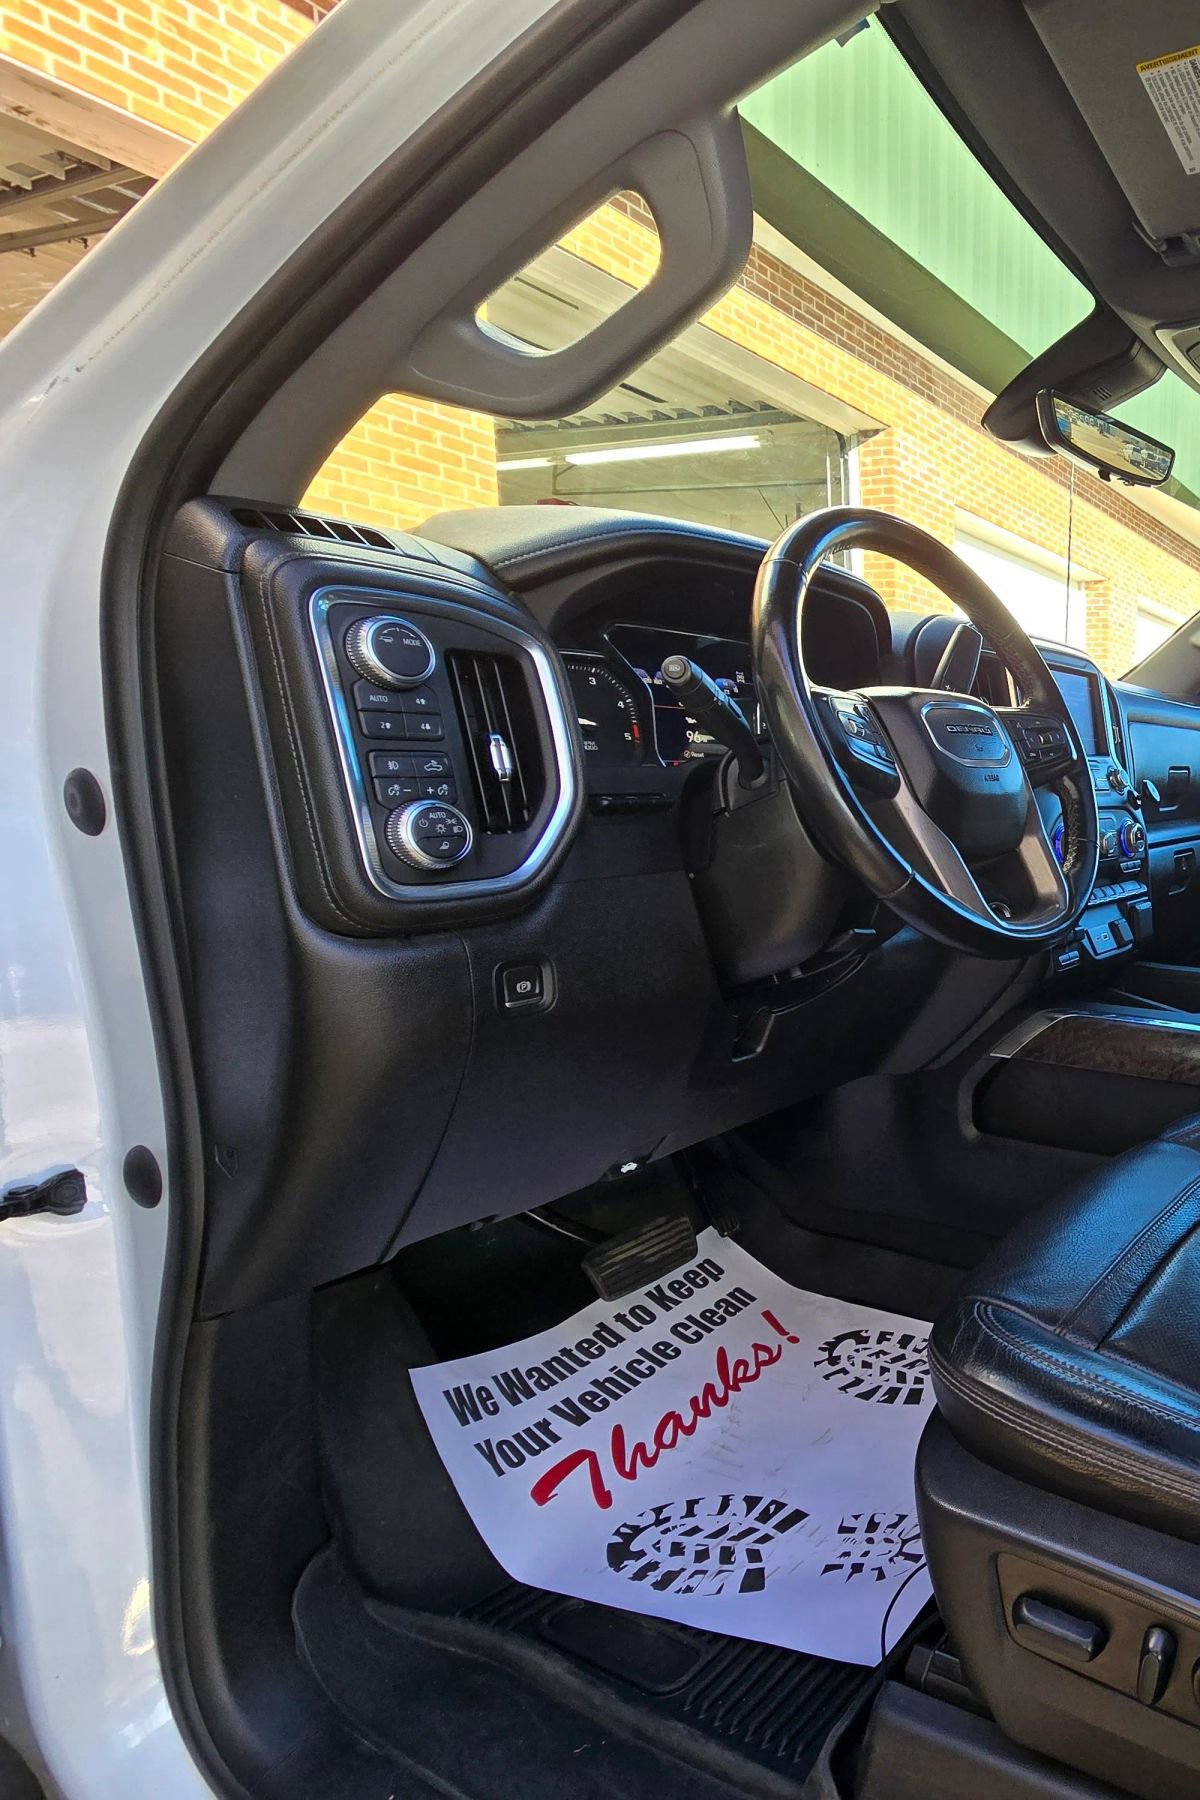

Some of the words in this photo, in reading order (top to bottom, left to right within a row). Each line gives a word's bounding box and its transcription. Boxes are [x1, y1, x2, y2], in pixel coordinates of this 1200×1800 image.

[403, 638, 422, 647] MODE
[588, 676, 597, 685] 3
[370, 694, 389, 703] AUTO
[617, 701, 625, 709] 4
[624, 732, 632, 741] 5
[429, 811, 446, 819] AUTO
[443, 1384, 500, 1427] We
[492, 1322, 627, 1407] Wanted
[613, 1304, 657, 1333] to
[644, 1257, 726, 1313] Keep
[474, 1418, 562, 1477] Your
[547, 1341, 682, 1427] Vehicle
[670, 1286, 758, 1345] Clean
[530, 1310, 801, 1509] Thanks!
